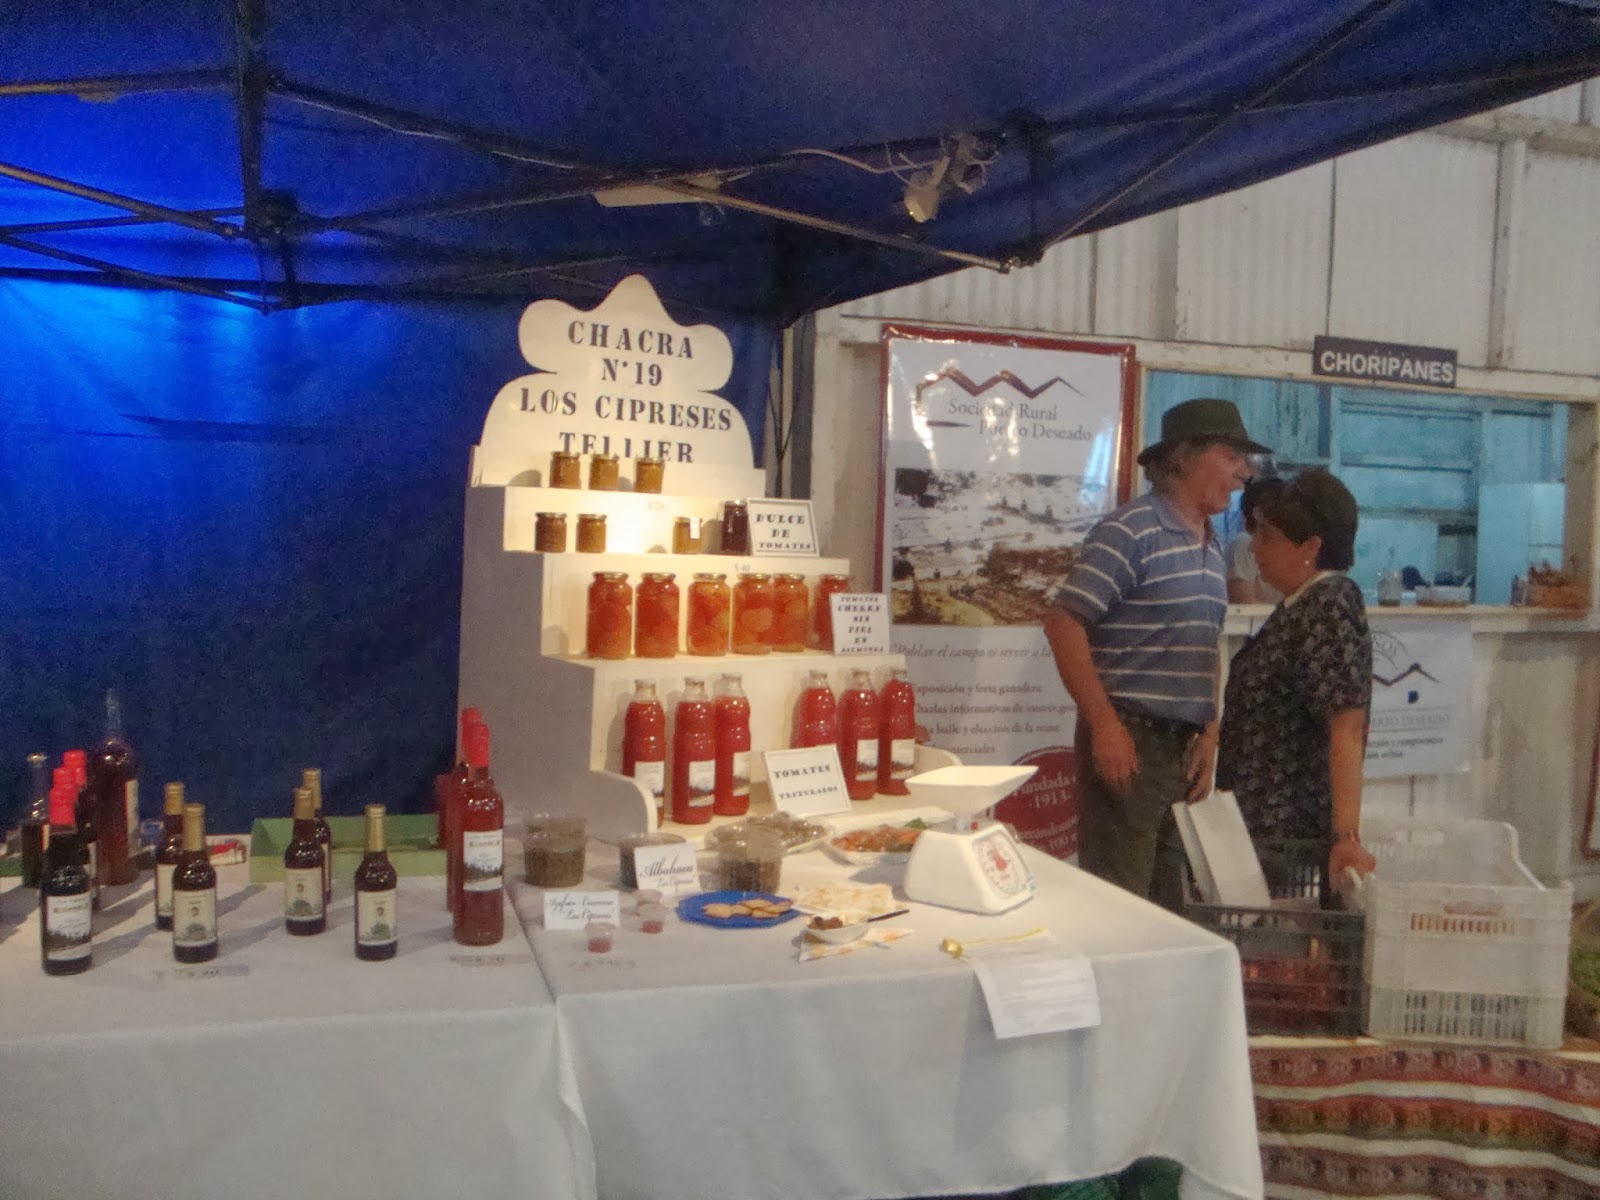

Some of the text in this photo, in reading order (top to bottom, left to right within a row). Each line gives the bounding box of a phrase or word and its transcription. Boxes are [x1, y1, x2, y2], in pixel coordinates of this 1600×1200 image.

[568, 320, 693, 359] CHACRA
[1320, 351, 1454, 383] CHORIPANES
[519, 387, 732, 432] LOS CIPRESES
[1020, 403, 1057, 420] Rural
[1032, 423, 1091, 441] Deseado
[756, 514, 805, 524] DULCE
[771, 528, 791, 538] DE
[917, 682, 965, 697] xposición
[917, 703, 947, 714] harlas
[774, 764, 831, 779] TOMATES
[1014, 771, 1072, 796] undada
